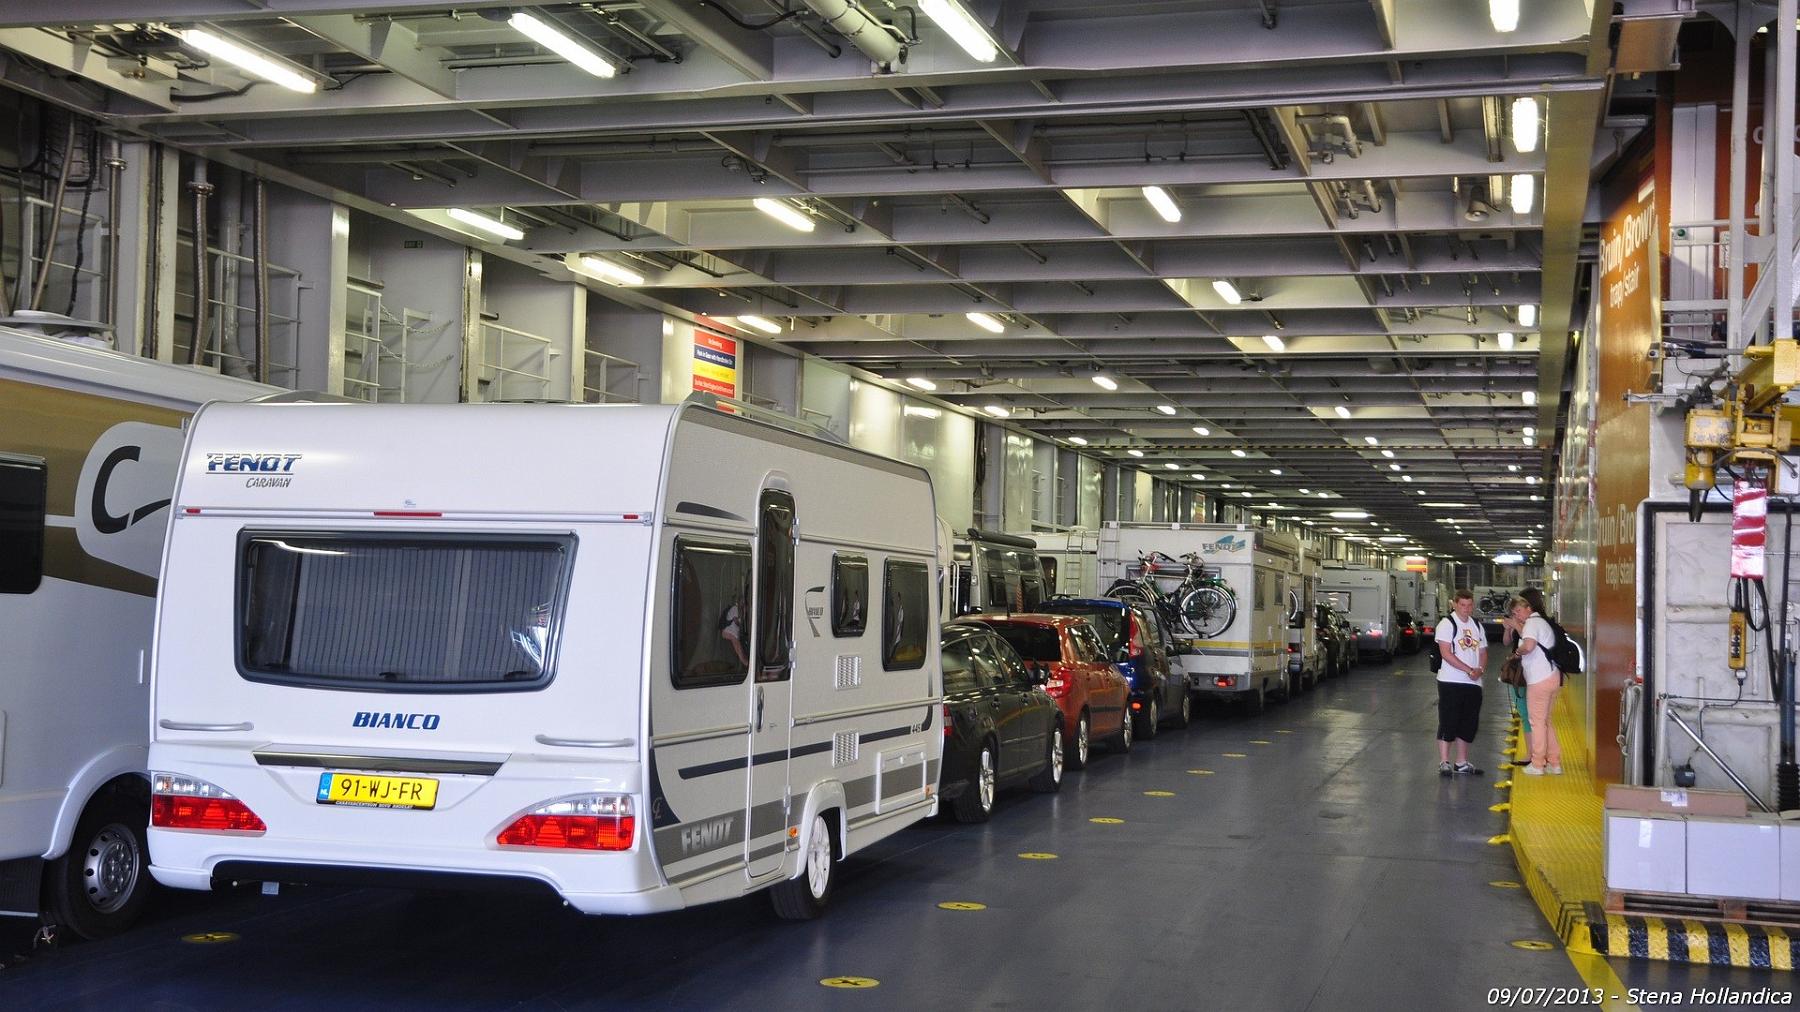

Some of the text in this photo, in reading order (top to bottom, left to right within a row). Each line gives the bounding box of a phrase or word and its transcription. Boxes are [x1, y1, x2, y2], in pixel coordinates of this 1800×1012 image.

[206, 453, 302, 472] FENDT
[245, 477, 291, 488] CARAVAN
[352, 711, 440, 730] BIANCO
[341, 778, 423, 800] 91-WJ-FR
[681, 816, 735, 857] FENDT
